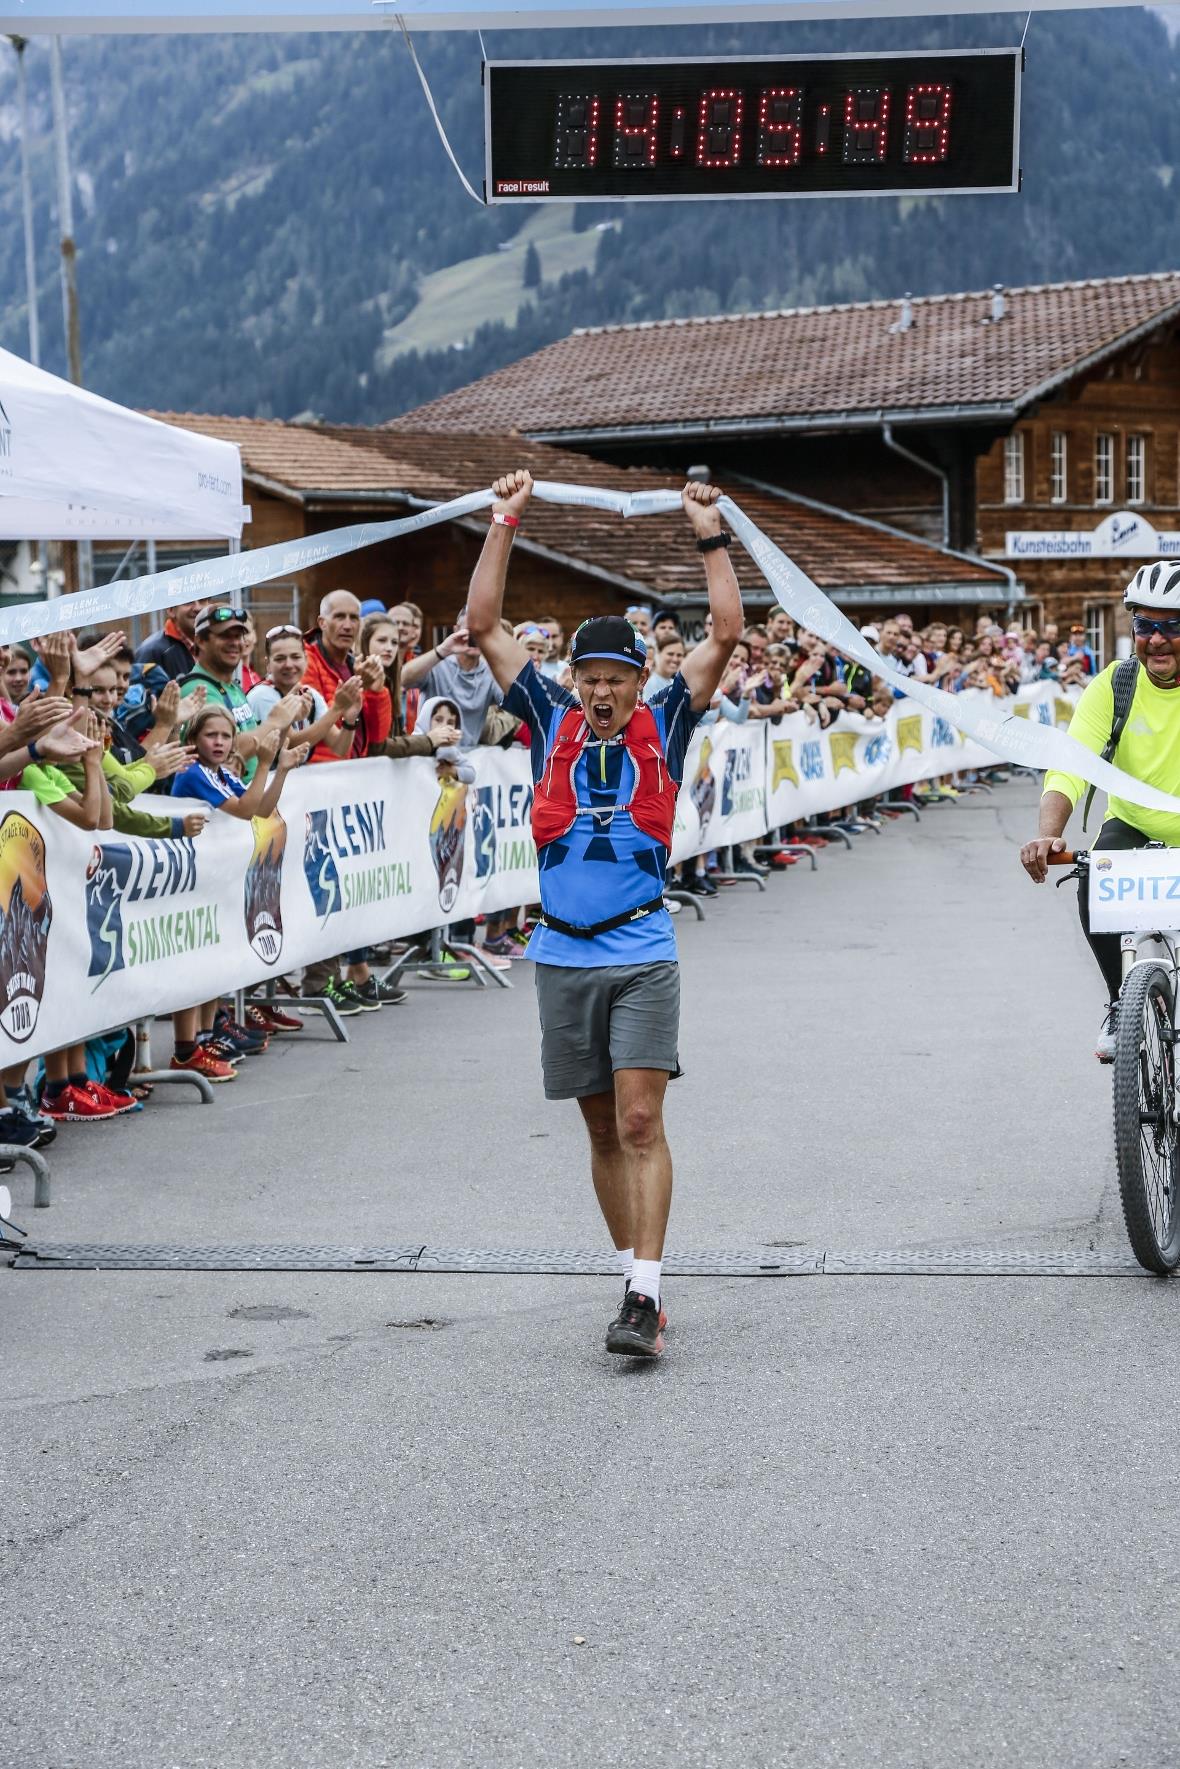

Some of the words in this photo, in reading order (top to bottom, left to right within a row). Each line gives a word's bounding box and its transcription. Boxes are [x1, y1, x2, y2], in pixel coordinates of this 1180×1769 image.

[589, 84, 952, 168] 14:05:49
[198, 472, 232, 497] pro-tent.com
[1012, 532, 1092, 554] Kunsteisbahn
[330, 800, 386, 858] LENK
[497, 784, 534, 828] LEN
[128, 838, 197, 902] LENK
[343, 861, 412, 909] SIMMENTAL
[1098, 875, 1180, 902] SPITZ
[128, 904, 221, 967] SIMMENTAL
[10, 1001, 31, 1033] TOUR
